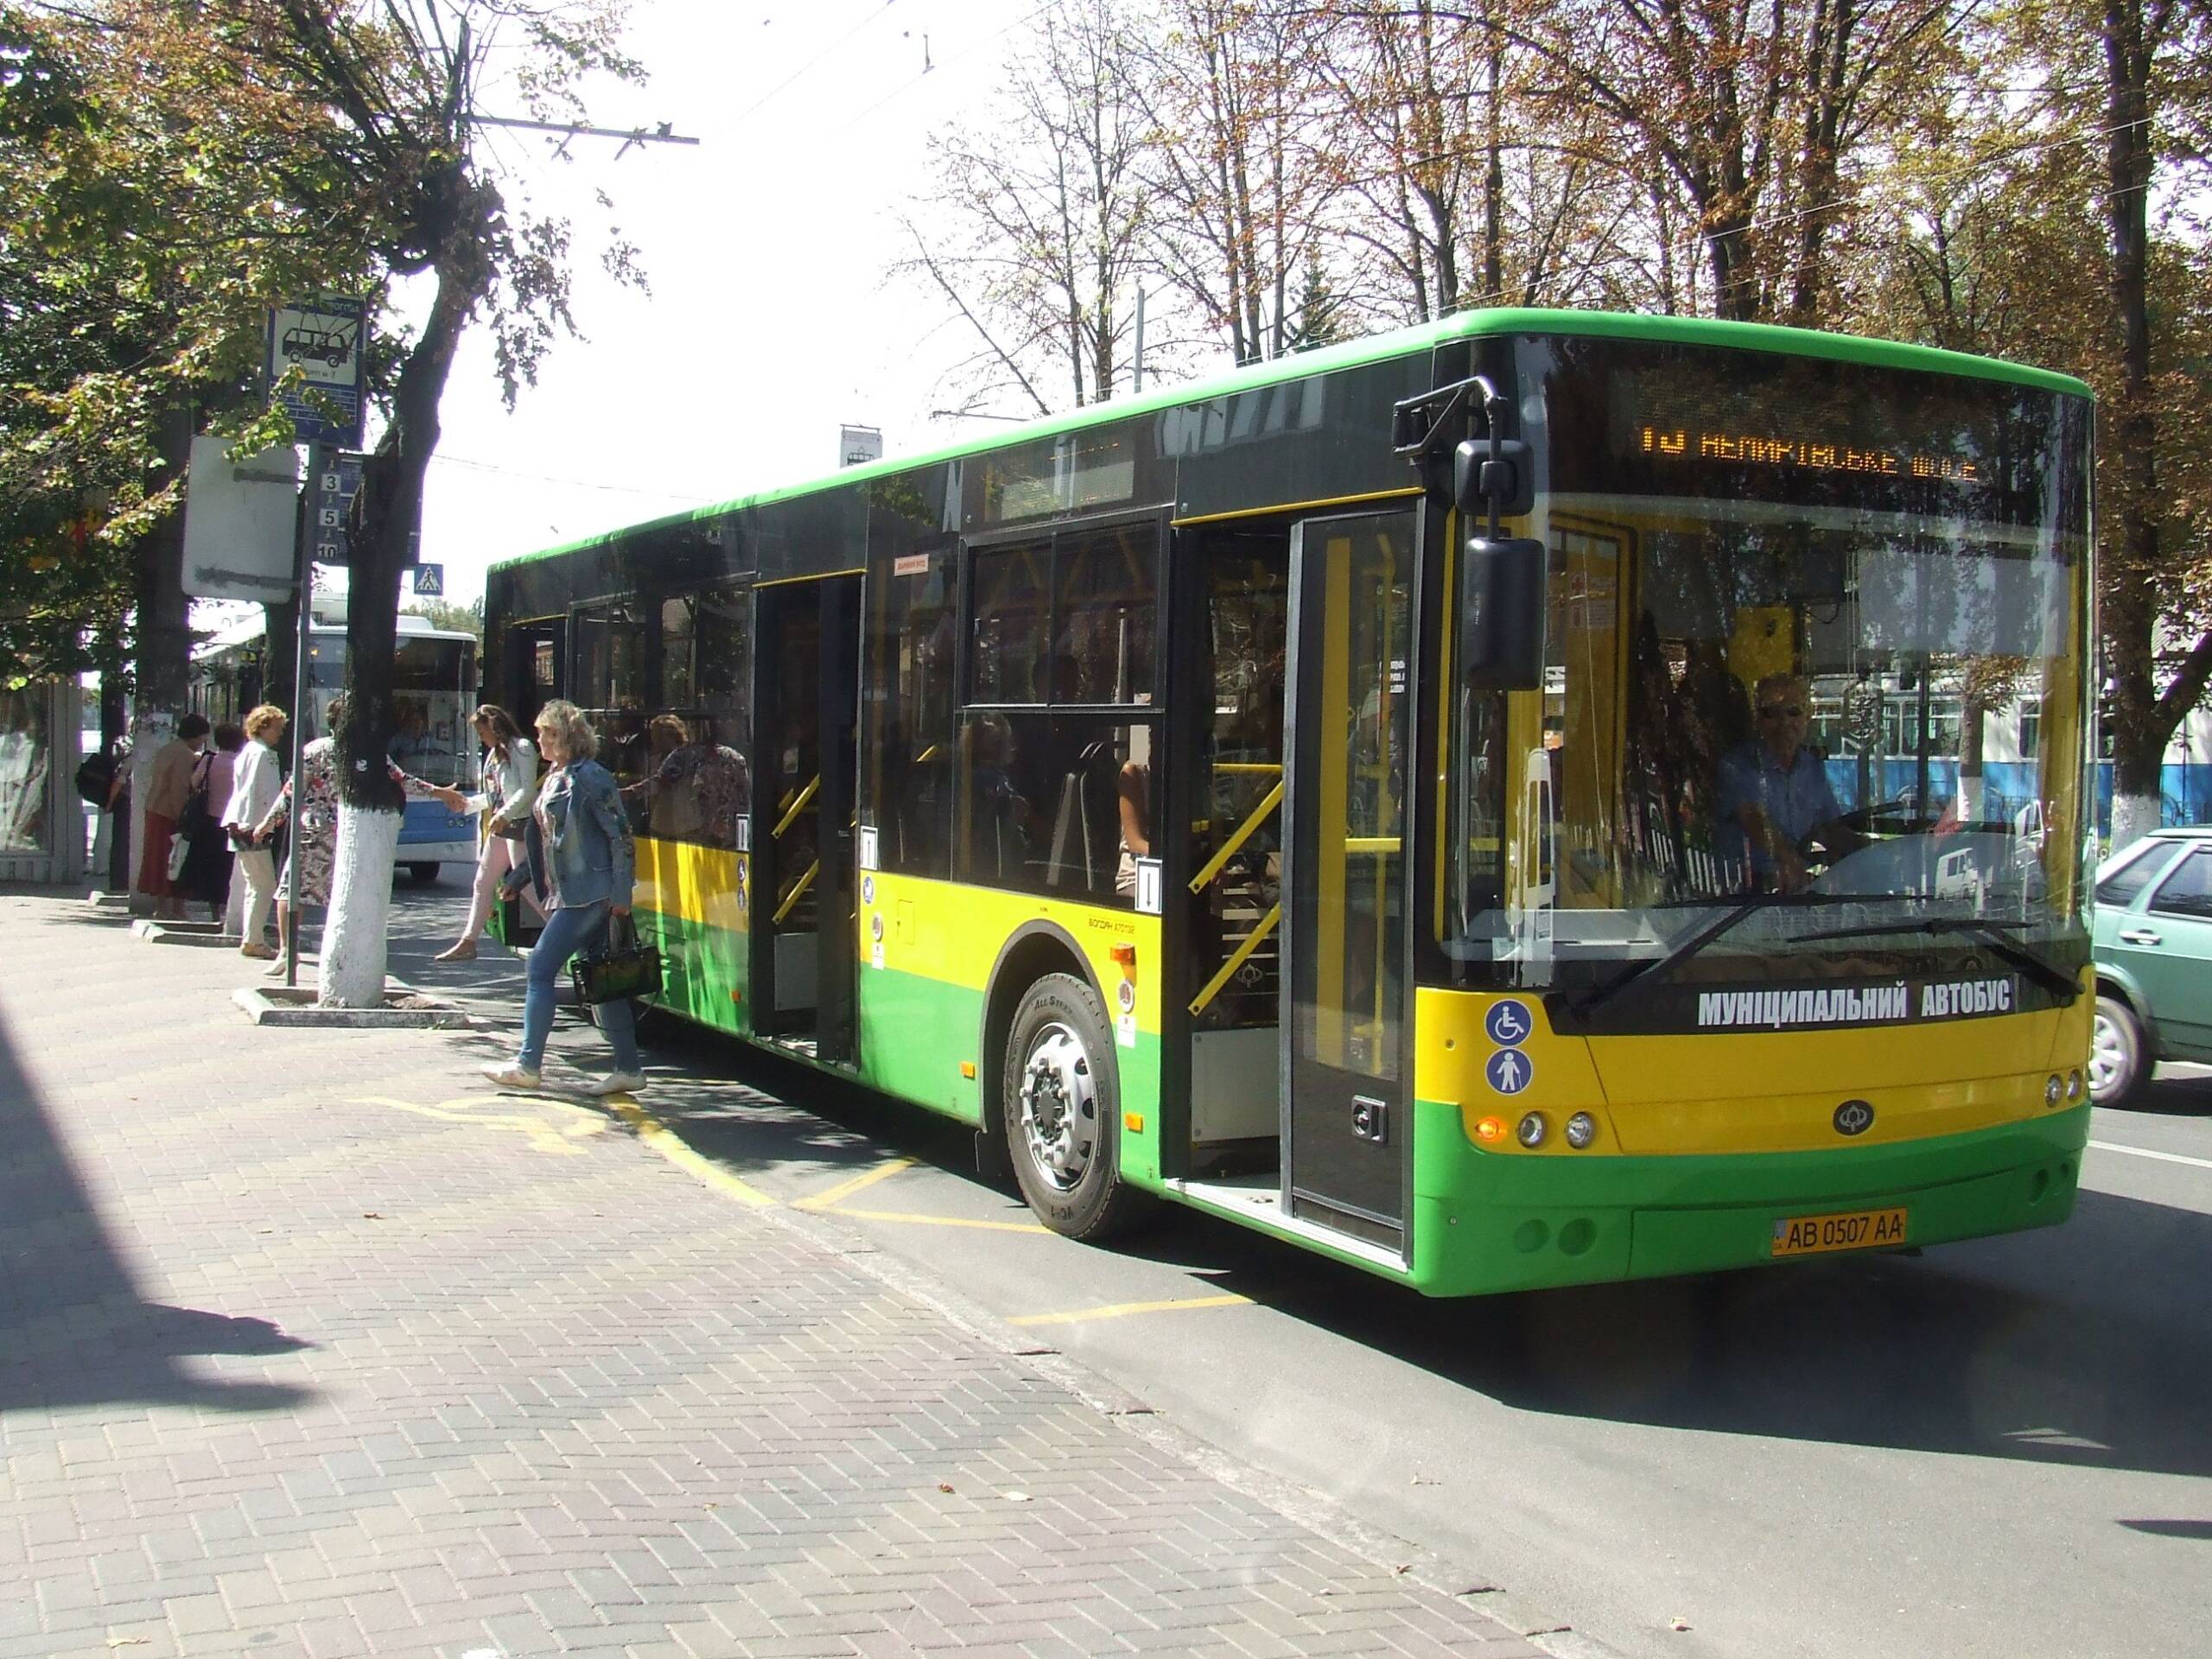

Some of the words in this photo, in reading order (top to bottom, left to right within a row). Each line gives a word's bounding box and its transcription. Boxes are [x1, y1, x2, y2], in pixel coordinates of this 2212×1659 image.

[326, 475, 336, 490] 3
[325, 511, 335, 525] 5
[318, 545, 336, 557] 10
[1698, 980, 1908, 1029] МУНІЦИПАЛЬНИЙ
[1921, 979, 2011, 1018] АВТОБУС
[1787, 1222, 1818, 1249] AB
[1823, 1216, 1870, 1246] 0507
[1873, 1213, 1904, 1241] AA
